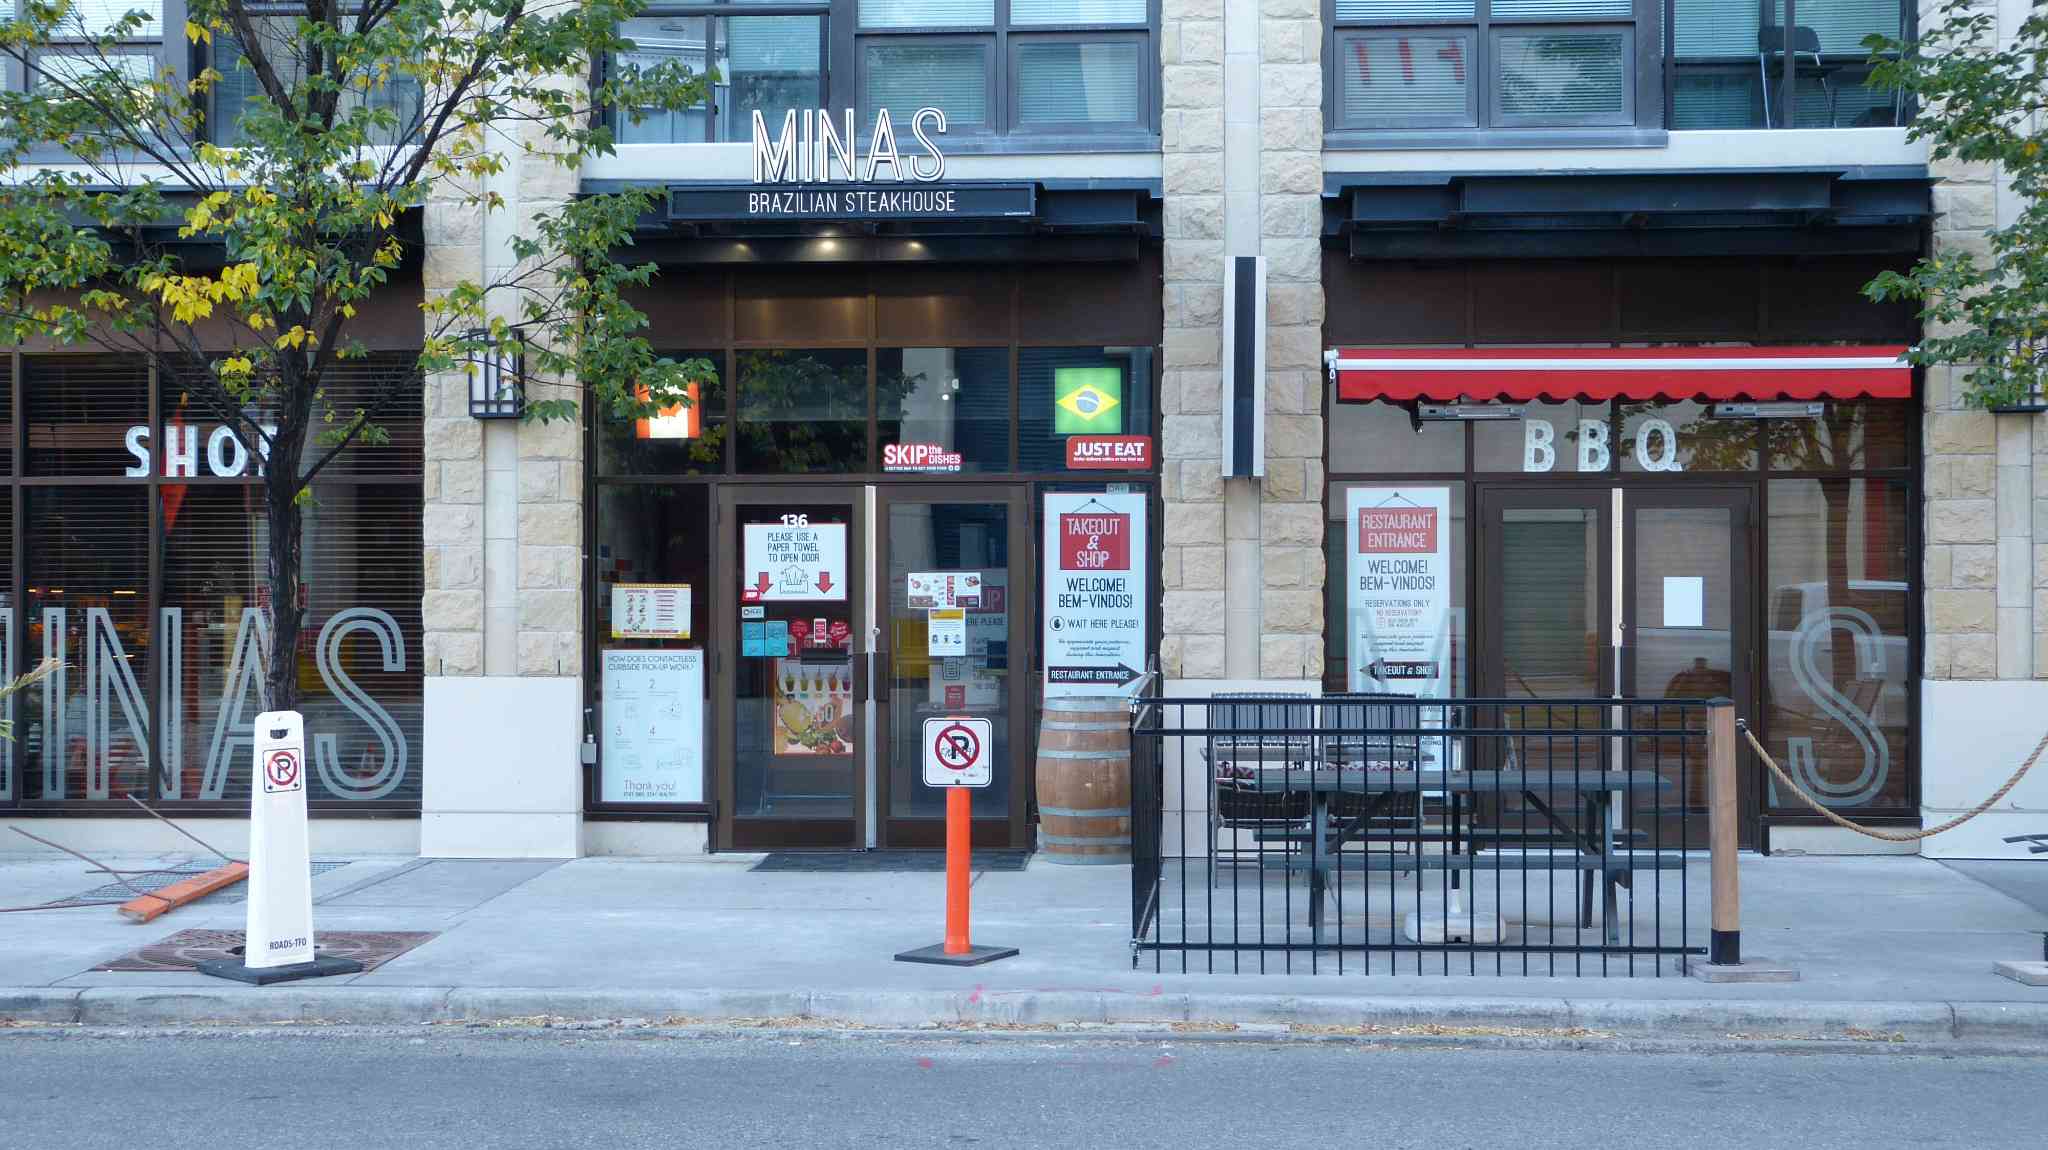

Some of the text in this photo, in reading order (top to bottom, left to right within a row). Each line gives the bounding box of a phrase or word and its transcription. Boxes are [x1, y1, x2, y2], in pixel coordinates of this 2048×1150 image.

[752, 107, 947, 183] MINAS
[749, 191, 955, 214] BRAZILIAN STEAKHOUSE
[1073, 442, 1145, 456] JUST EAT
[1523, 419, 1683, 472] BBQ
[884, 444, 943, 465] SKIP the
[928, 454, 961, 464] DISHES
[780, 514, 808, 528] 136
[1066, 518, 1121, 535] TAKEOUT
[1362, 514, 1432, 530] RESTAURANT
[767, 532, 818, 542] PLEASE USE A
[1086, 535, 1099, 550] &
[1367, 533, 1427, 548] ENTRANCE
[767, 543, 819, 552] PAPER TOWEL
[768, 553, 820, 562] TO OPEN DOOR
[1076, 551, 1110, 568] SHOP
[1367, 559, 1429, 574] WELCOME!
[1066, 577, 1126, 593] WELCOME!
[1359, 576, 1436, 591] BEM-VINDOS!
[1058, 593, 1133, 609] BEM-VINDOS!
[1364, 599, 1430, 608] RESERVATIONS ONLY
[1067, 618, 1140, 629] WAIT HERE PLEASE!
[1051, 670, 1130, 680] RESTAURANT ENTRANCE
[615, 680, 622, 689] 1
[649, 680, 656, 689] 2
[615, 727, 622, 736] 3
[649, 727, 656, 736] 4
[623, 779, 653, 791] Thank
